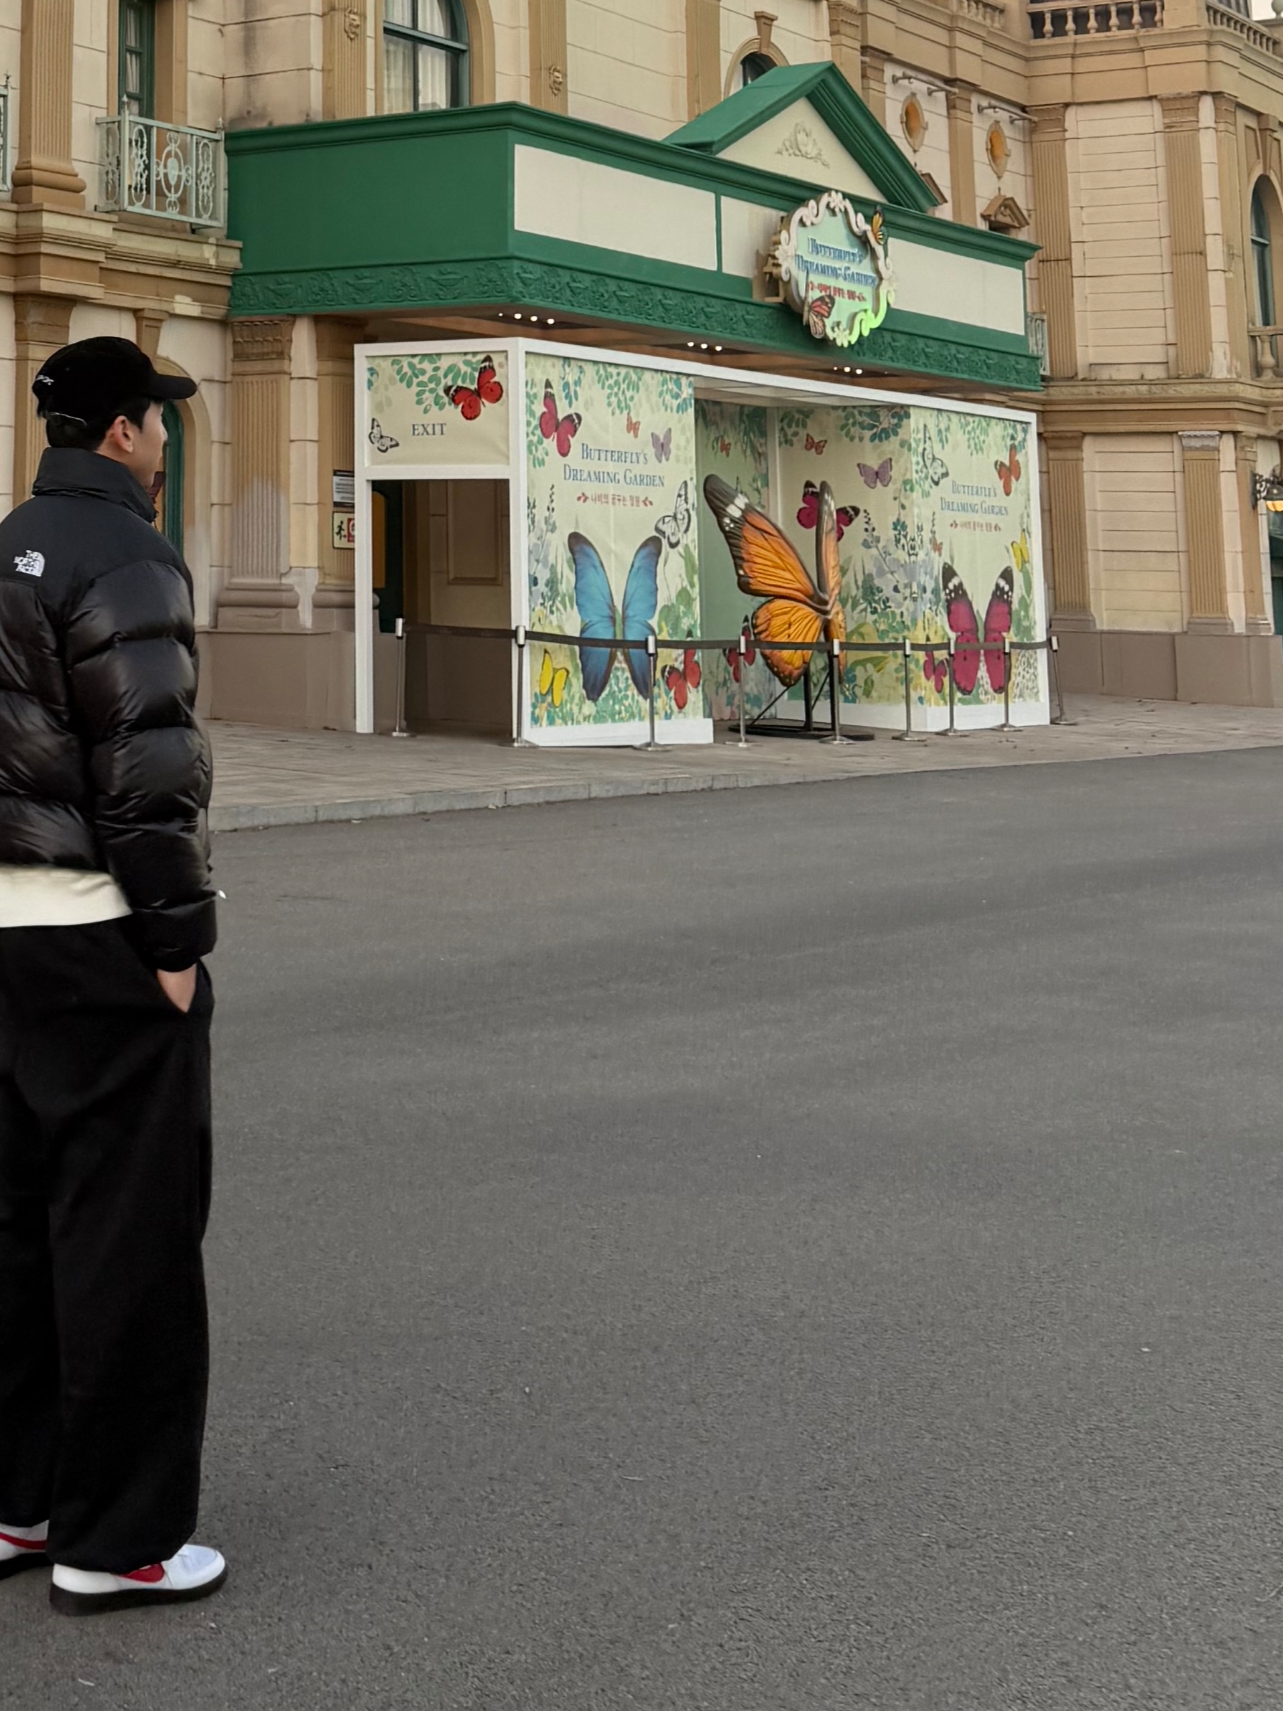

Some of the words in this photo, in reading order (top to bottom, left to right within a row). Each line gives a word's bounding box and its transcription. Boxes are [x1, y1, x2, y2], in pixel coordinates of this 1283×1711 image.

[411, 422, 447, 437] EXIT
[563, 463, 620, 485] DREAMING
[623, 468, 665, 487] GARDEN
